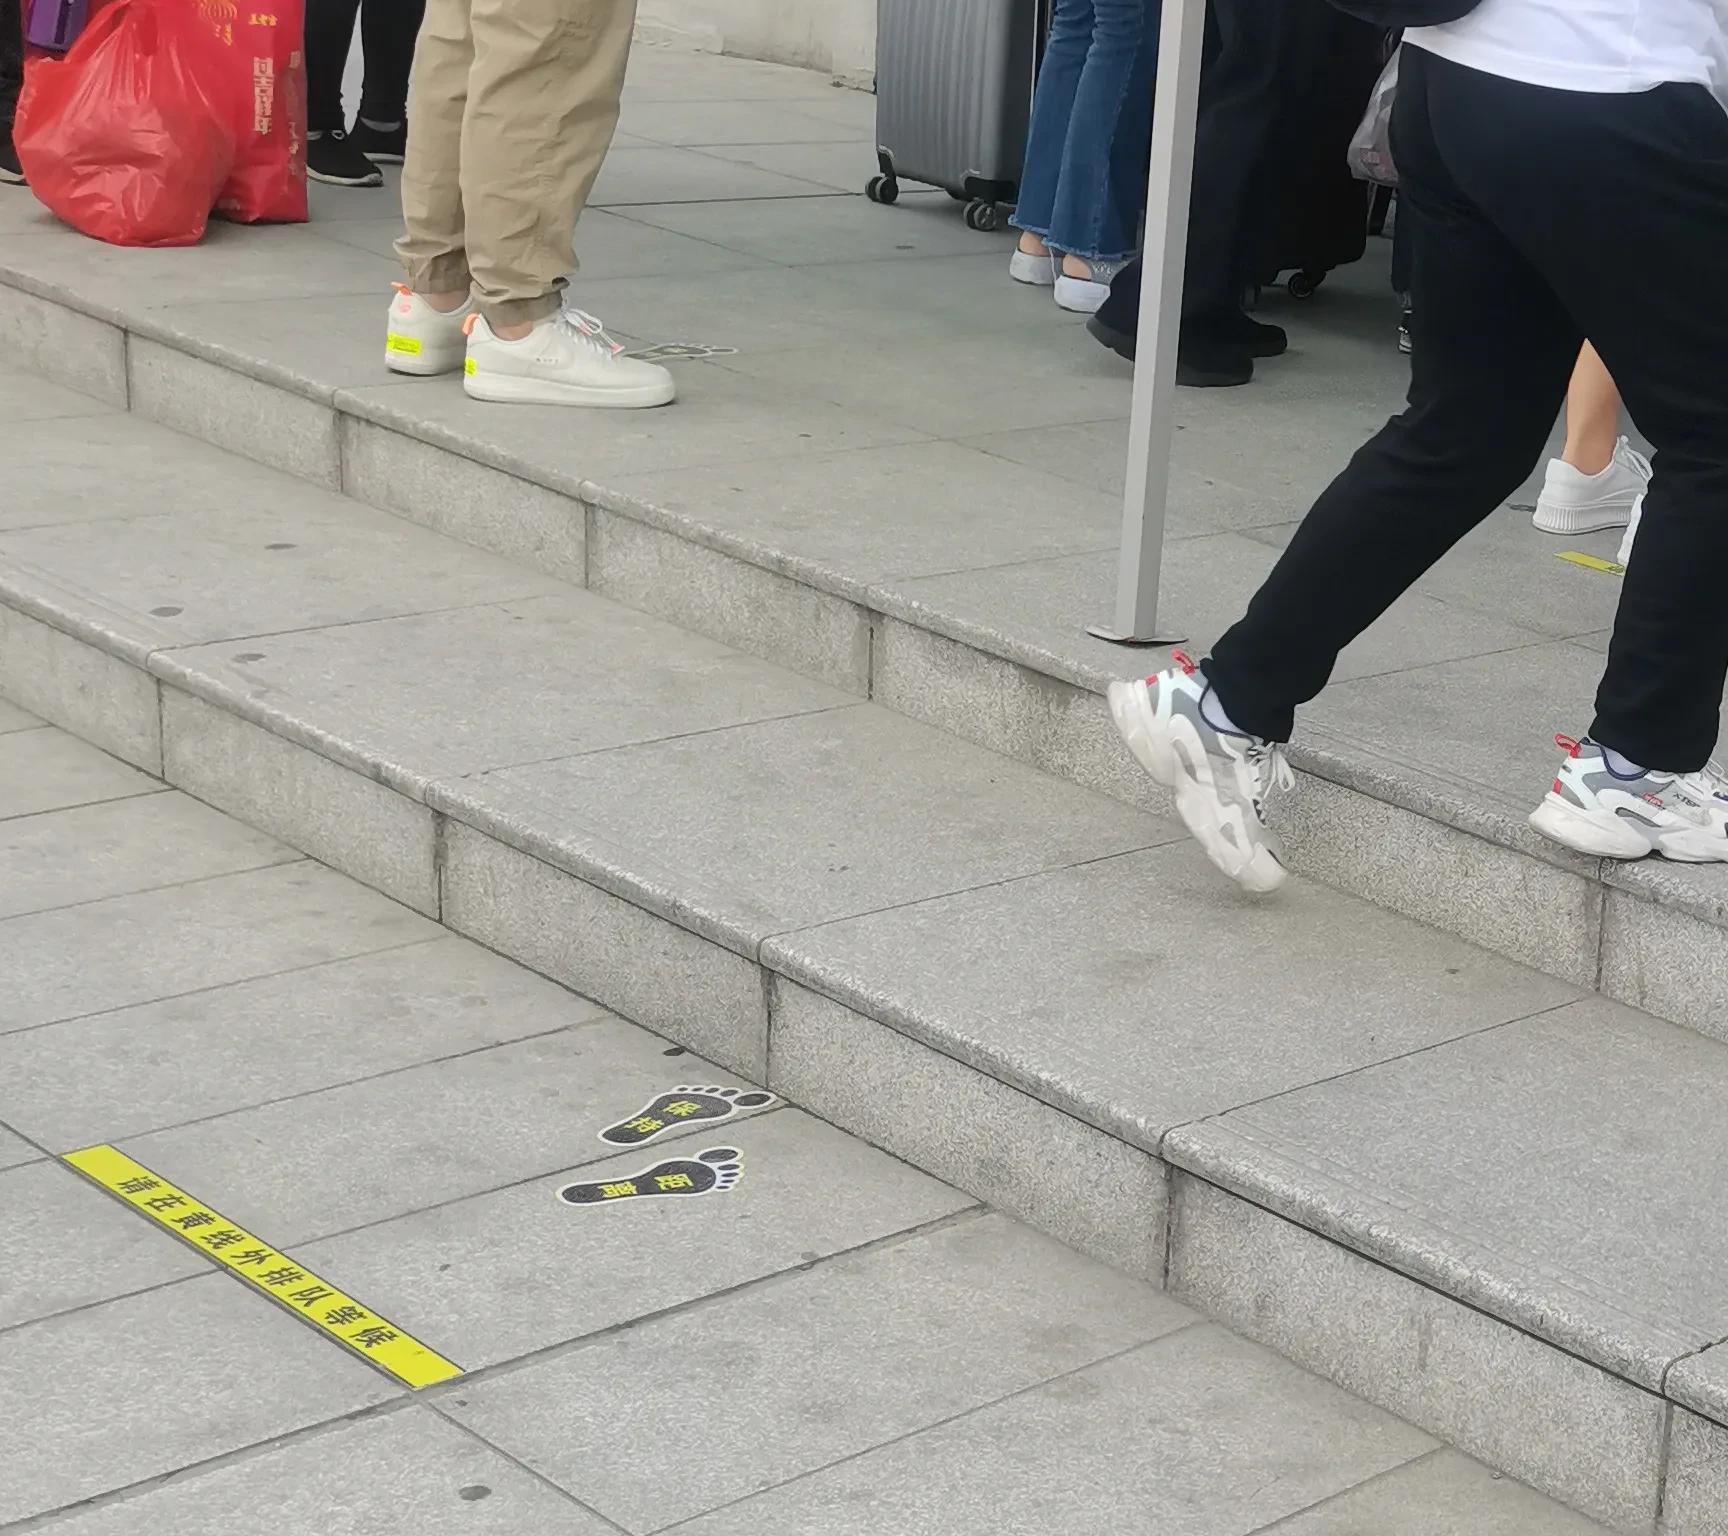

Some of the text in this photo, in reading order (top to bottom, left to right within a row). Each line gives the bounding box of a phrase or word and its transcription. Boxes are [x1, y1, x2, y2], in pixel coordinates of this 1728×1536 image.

[115, 1175, 398, 1350] 请在黄线外排队等候
